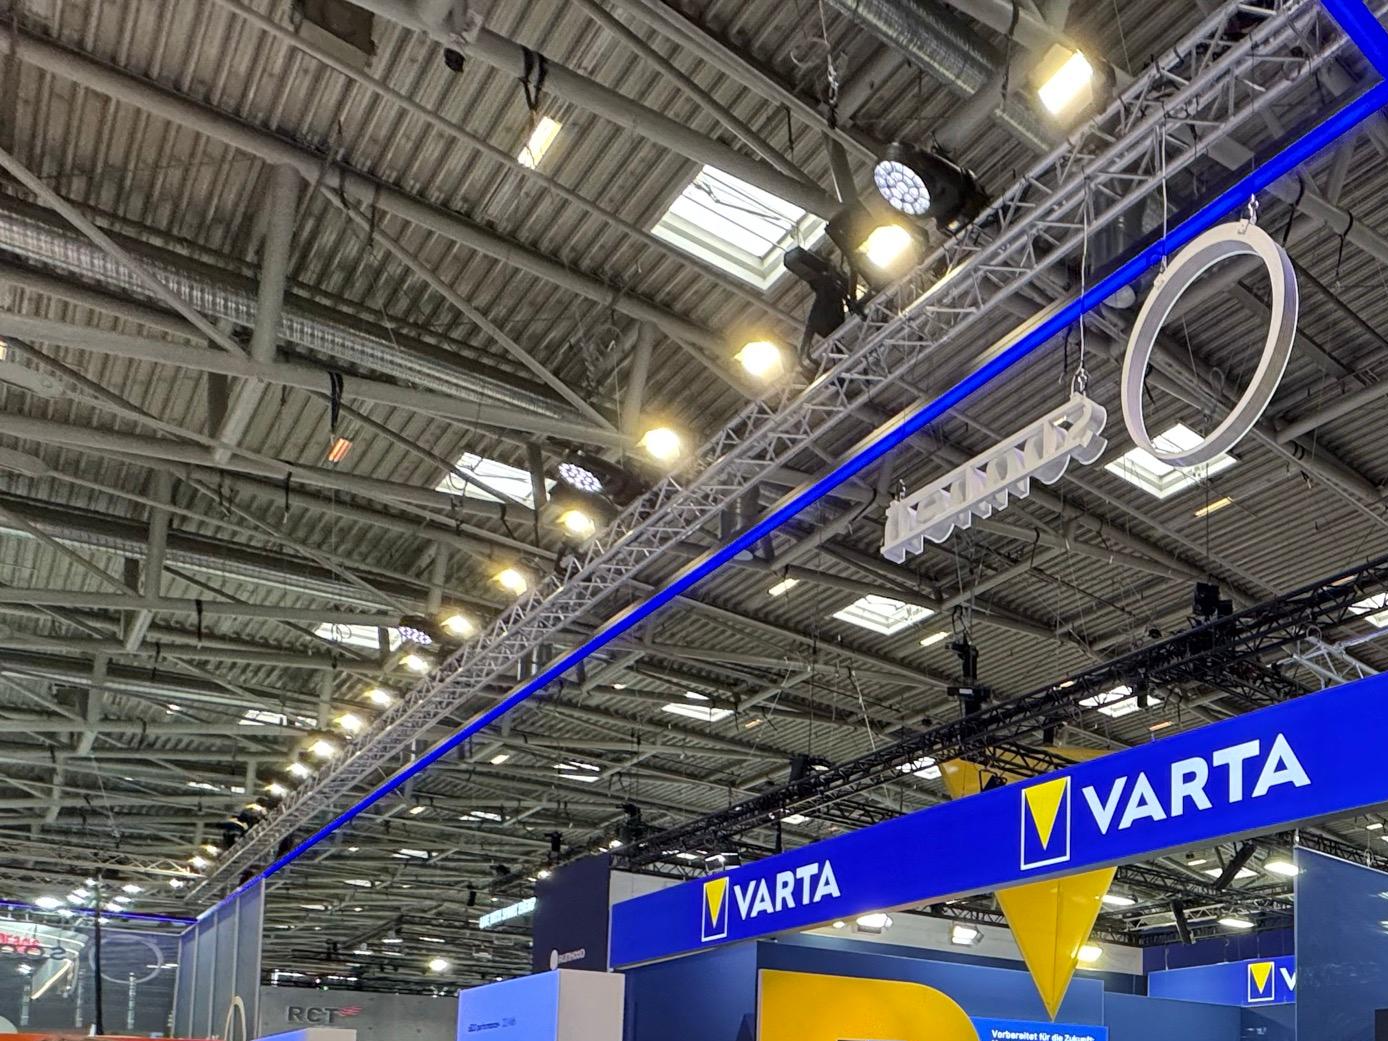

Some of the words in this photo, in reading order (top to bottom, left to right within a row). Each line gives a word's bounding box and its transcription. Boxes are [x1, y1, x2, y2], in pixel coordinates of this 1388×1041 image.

[1082, 733, 1311, 835] VARTA
[734, 860, 841, 920] VARTA
[288, 1006, 339, 1023] RCT
[991, 1030, 1037, 1040] Vorbereitet
[1039, 1032, 1050, 1041] für
[1051, 1033, 1063, 1041] die
